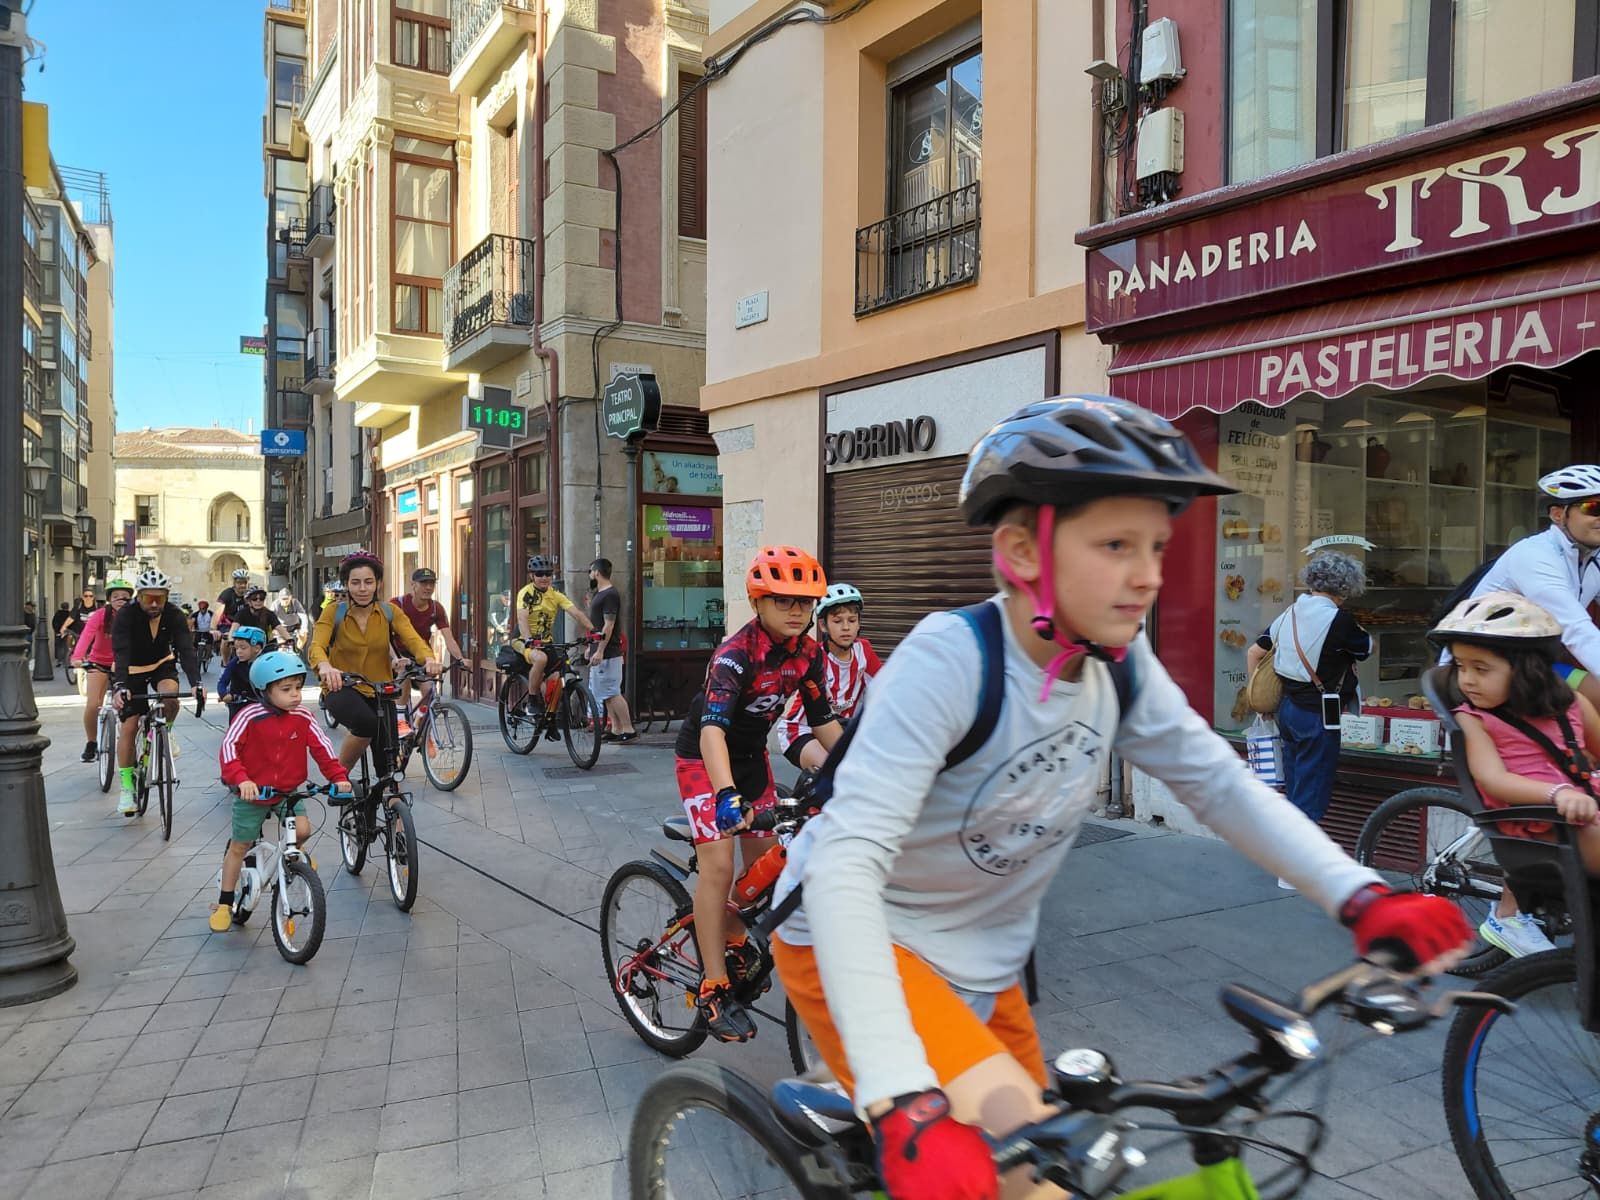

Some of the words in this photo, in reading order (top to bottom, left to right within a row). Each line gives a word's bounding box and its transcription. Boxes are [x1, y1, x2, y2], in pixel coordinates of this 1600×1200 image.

[1107, 220, 1317, 300] PANADERIA
[1259, 310, 1553, 396] PASTELERIA
[610, 388, 633, 406] TEATRO
[473, 405, 521, 429] 11:03
[609, 407, 638, 427] PRINCIPAL
[824, 415, 936, 466] SOBRINO
[879, 481, 942, 513] joyeros
